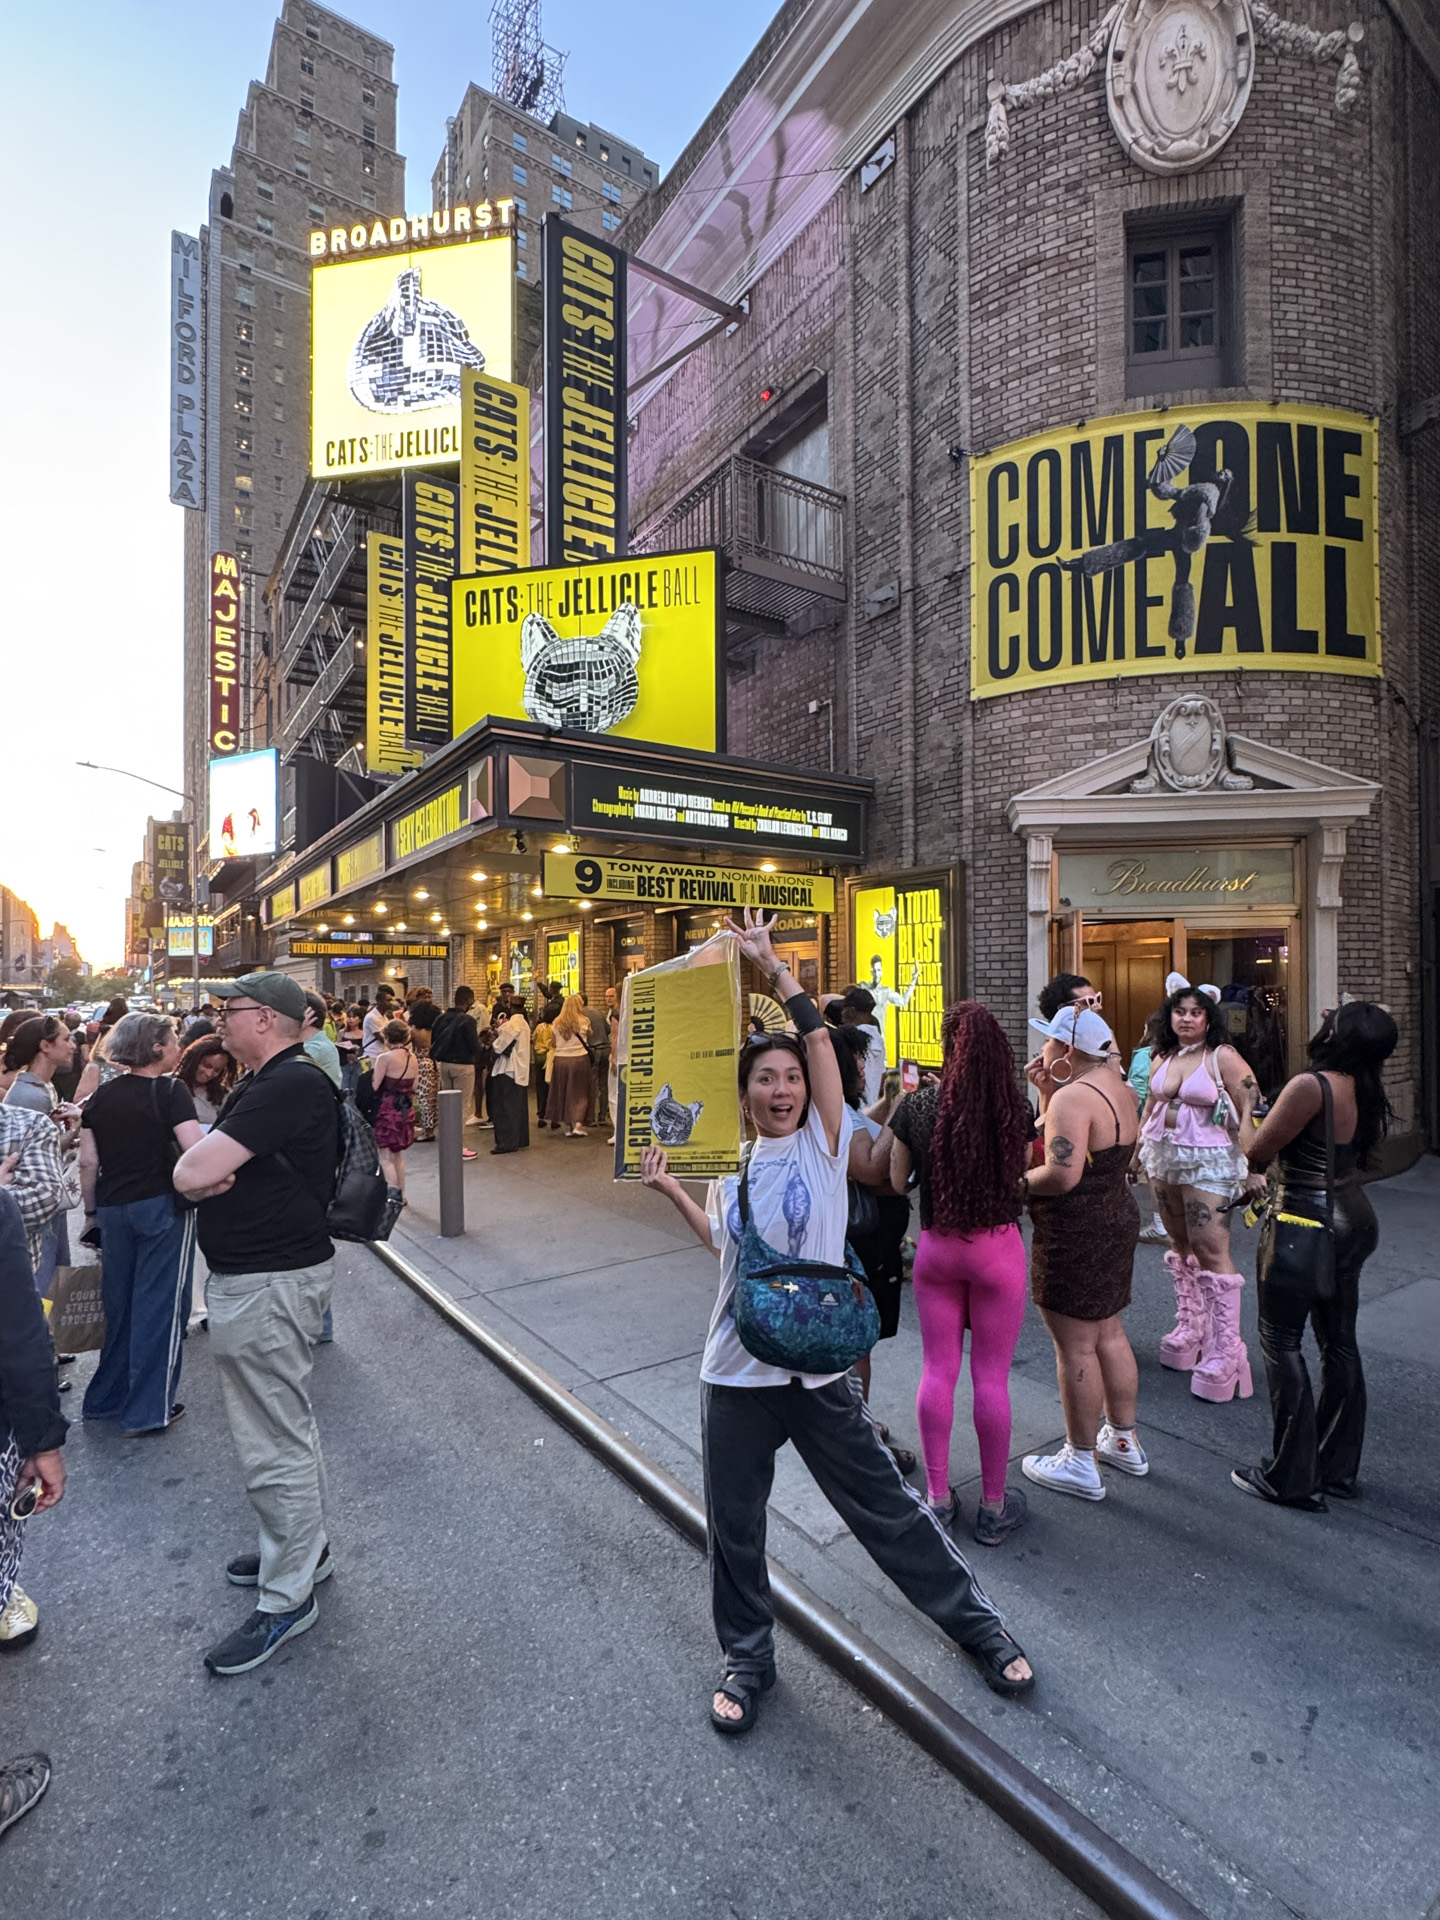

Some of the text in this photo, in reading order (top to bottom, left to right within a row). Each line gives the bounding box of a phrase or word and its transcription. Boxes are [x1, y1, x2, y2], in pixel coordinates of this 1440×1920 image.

[310, 199, 515, 256] BROADHURST
[172, 232, 199, 505] MILFORD PLAZA
[563, 338, 615, 396] THE
[375, 432, 394, 462] THE
[394, 425, 460, 460] JELLICL
[474, 464, 518, 507] THE
[563, 386, 616, 555] JELLICLE
[987, 420, 1364, 569] COME ONE
[474, 503, 518, 573] JELL
[416, 550, 455, 583] THE
[527, 581, 554, 619] THE
[558, 571, 658, 618] JELLICLE
[663, 566, 701, 608] BALL
[987, 541, 1367, 679] COME ALL
[213, 554, 239, 751] MAJESTIC
[415, 582, 449, 692] JELLICLE
[379, 632, 405, 729] JELLICLE
[416, 693, 449, 733] BALL
[379, 729, 414, 766] BALL
[668, 791, 688, 808] LLOYD
[157, 834, 185, 852] CATS
[157, 858, 185, 870] JELLICLE
[574, 859, 814, 894] 9 TONY AWARD NOMINATIONS
[1091, 858, 1259, 896] Broadhurst
[606, 875, 815, 908] INCLUDING BEST REVIVAL OF A MUSICAL
[905, 888, 943, 924] TOTAL
[170, 931, 208, 949] BEACES
[685, 929, 706, 941] NEW
[770, 916, 820, 932] ROADWA
[898, 922, 943, 964] BLAST
[633, 976, 656, 1004] BALL
[917, 962, 943, 986] START
[630, 1006, 655, 1077] JELLICLE
[898, 1011, 943, 1043] WILDLY
[629, 1078, 653, 1101] THE
[65, 1301, 103, 1314] STREET
[70, 1289, 102, 1301] COURT
